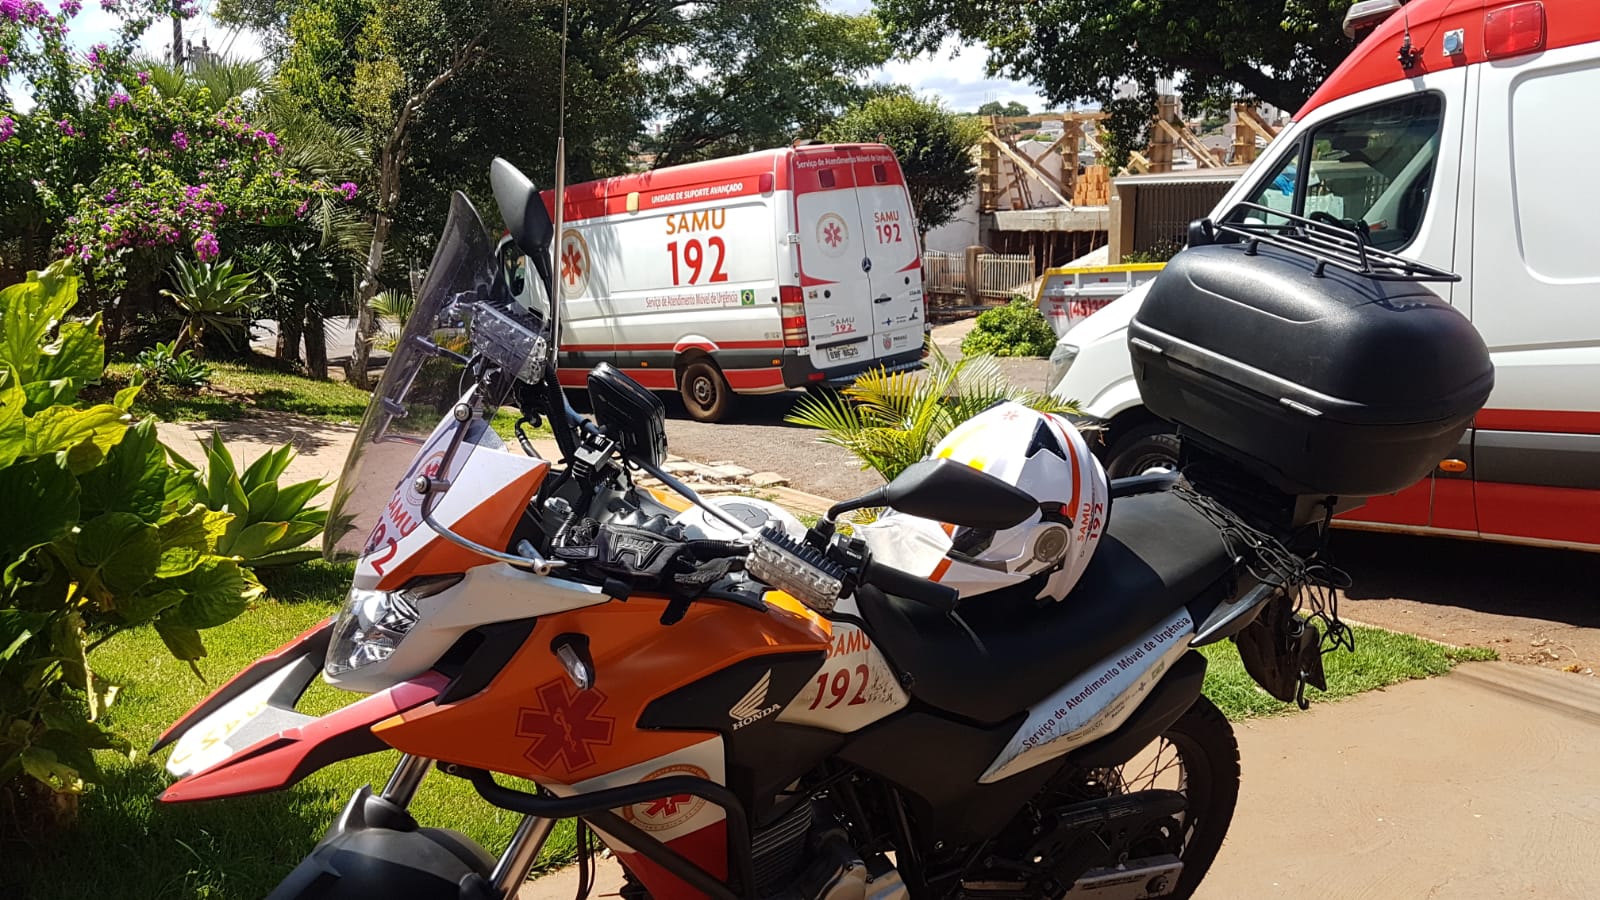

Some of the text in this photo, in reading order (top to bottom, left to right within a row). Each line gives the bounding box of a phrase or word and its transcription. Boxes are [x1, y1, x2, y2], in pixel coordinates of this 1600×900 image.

[796, 160, 817, 169] Serviço
[651, 182, 743, 204] UNIDADE DE SUPORTE AVANÇADO
[666, 207, 726, 235] SAMU
[874, 210, 899, 223] SAMU
[876, 223, 902, 244] 192
[667, 236, 728, 286] 192
[646, 296, 661, 309] Serviço
[668, 294, 695, 306] Atendimento
[717, 291, 738, 307] Urgência
[830, 317, 855, 326] SAMU
[835, 324, 853, 332] 192
[1077, 503, 1091, 542] SAMU
[1090, 502, 1104, 541] 192
[826, 627, 871, 660] SAMU
[808, 664, 870, 710] 192
[1022, 719, 1056, 750] Serviço
[1054, 708, 1068, 720] de
[1065, 666, 1120, 710] Atendimento
[1117, 647, 1146, 671] Móvel
[1143, 638, 1157, 652] de
[1154, 616, 1191, 643] Urgência
[732, 703, 782, 731] HONDA
